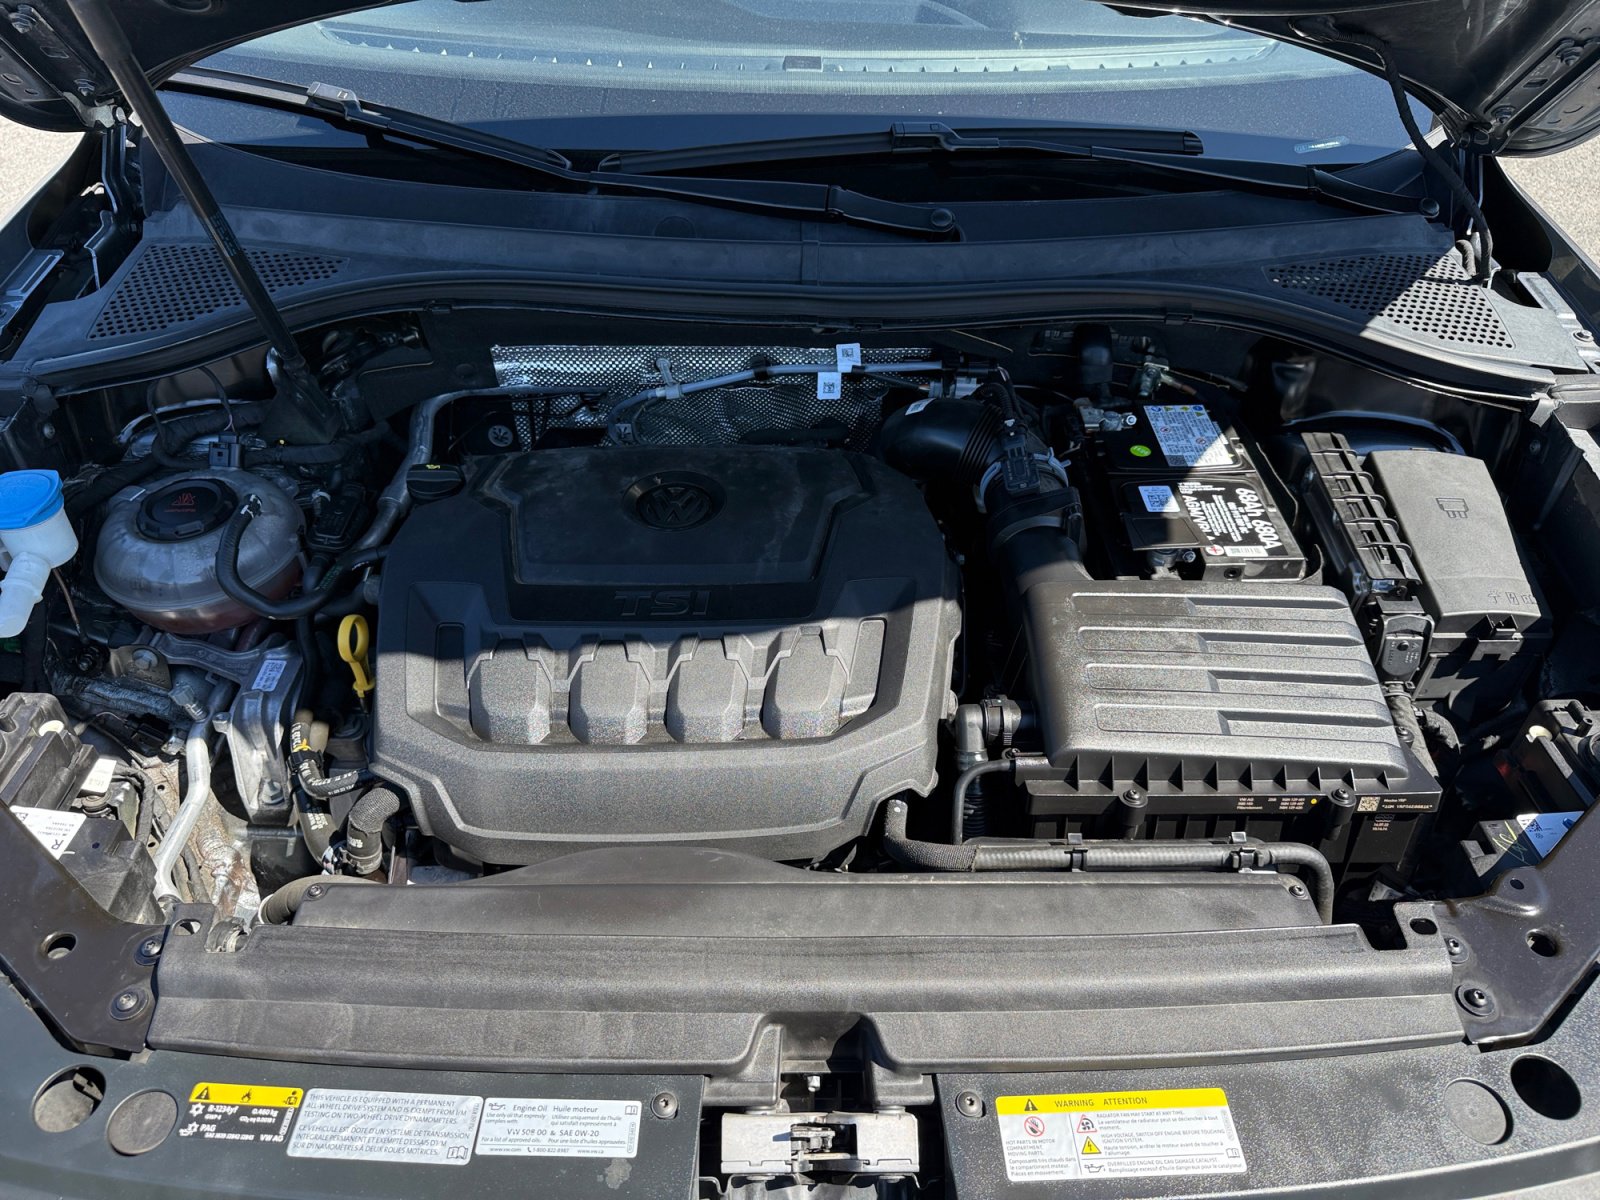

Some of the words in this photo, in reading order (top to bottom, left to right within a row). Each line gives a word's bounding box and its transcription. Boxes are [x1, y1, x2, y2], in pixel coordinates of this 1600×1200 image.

[1235, 488, 1265, 517] 68Ah
[1252, 520, 1282, 549] 680A
[615, 590, 711, 616] TSI
[51, 839, 64, 850] R
[359, 1096, 391, 1104] EQUIPPED
[416, 1099, 455, 1107] PERMANENT
[1055, 1099, 1094, 1108] WARNING
[1103, 1097, 1147, 1106] ATTENTION
[411, 1107, 436, 1115] EXEMPT
[513, 1105, 536, 1113] Engine
[538, 1105, 548, 1113] Oil
[344, 1113, 382, 1121] TWO-WHEEL
[199, 1124, 217, 1132] PAG
[423, 1131, 470, 1139] TRANSMISSION
